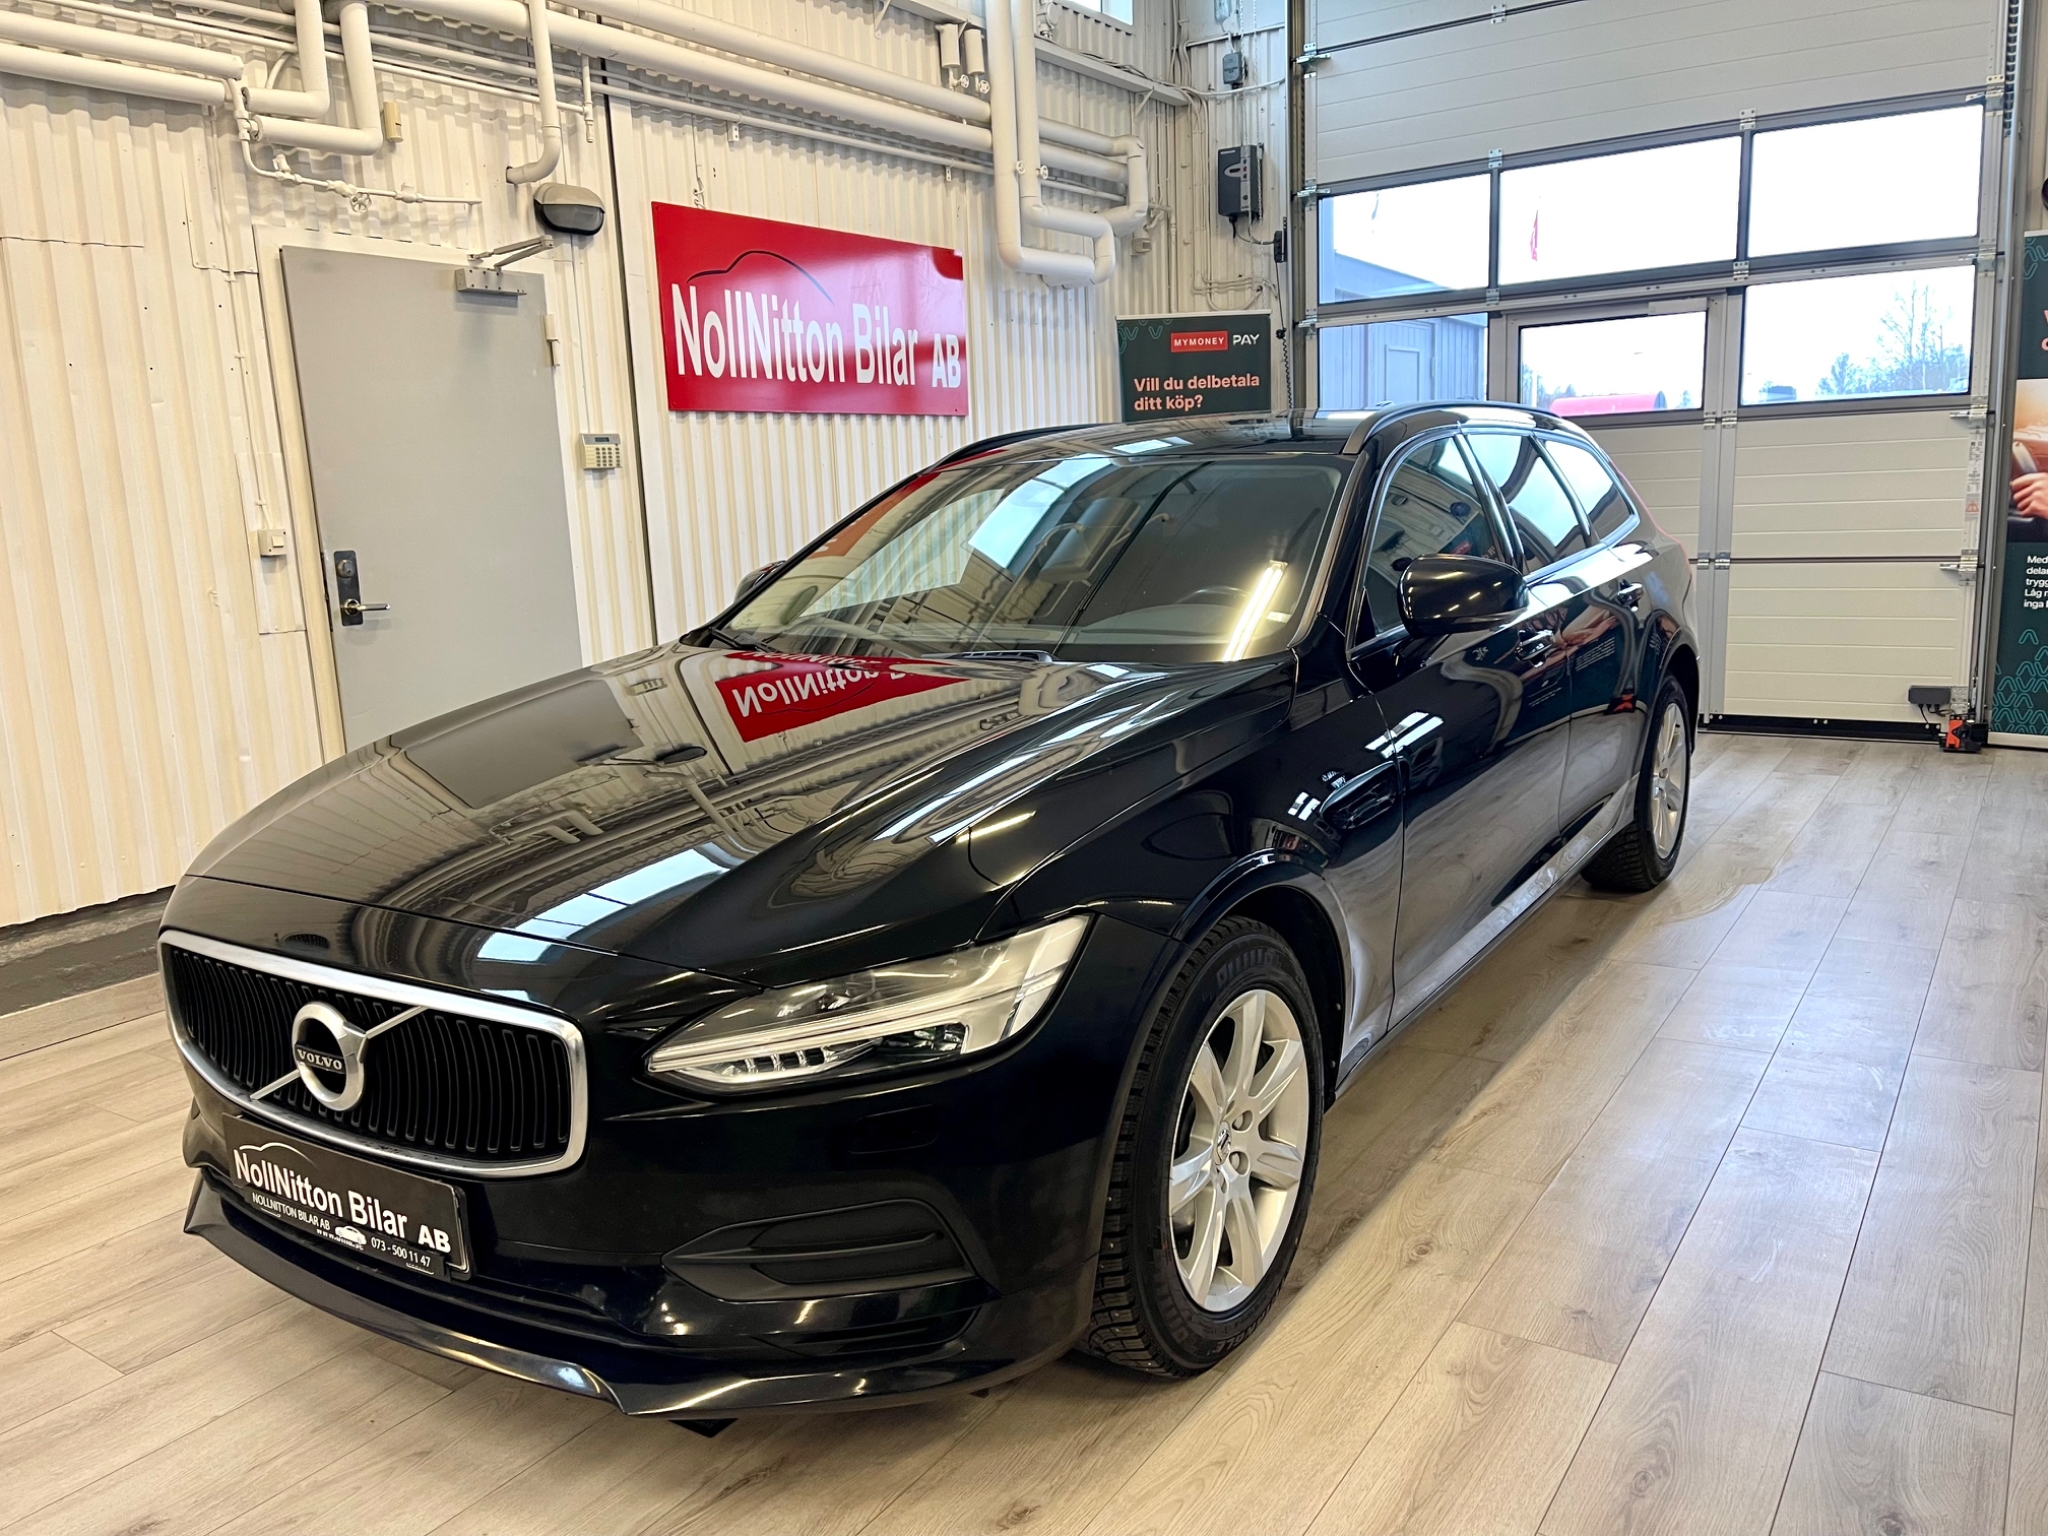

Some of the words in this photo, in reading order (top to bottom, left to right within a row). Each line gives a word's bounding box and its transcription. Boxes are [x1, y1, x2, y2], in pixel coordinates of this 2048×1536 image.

[672, 283, 845, 383] NollNitton
[852, 303, 918, 386] Bilar
[931, 333, 961, 388] AB
[1174, 337, 1225, 346] MYMONEY
[1233, 334, 1260, 345] PAY
[1133, 378, 1160, 392] Vill
[1163, 377, 1183, 391] du
[1188, 373, 1260, 389] delbetala
[1134, 396, 1162, 411] ditt
[1165, 394, 1204, 411] köp?
[2027, 556, 2048, 564] Med
[2025, 588, 2043, 598] Låg
[2024, 599, 2044, 609] inga
[297, 1049, 342, 1070] VOLVO
[233, 1148, 344, 1218] NollNitton
[347, 1190, 408, 1239] Bilar
[417, 1224, 451, 1253] AB
[252, 1192, 297, 1219] NOLLNITTON
[297, 1209, 319, 1227] BILAR
[319, 1218, 331, 1231] AB
[370, 1237, 386, 1252] 073
[392, 1244, 408, 1259] 500
[409, 1250, 419, 1263] 11
[420, 1255, 431, 1268] 47
